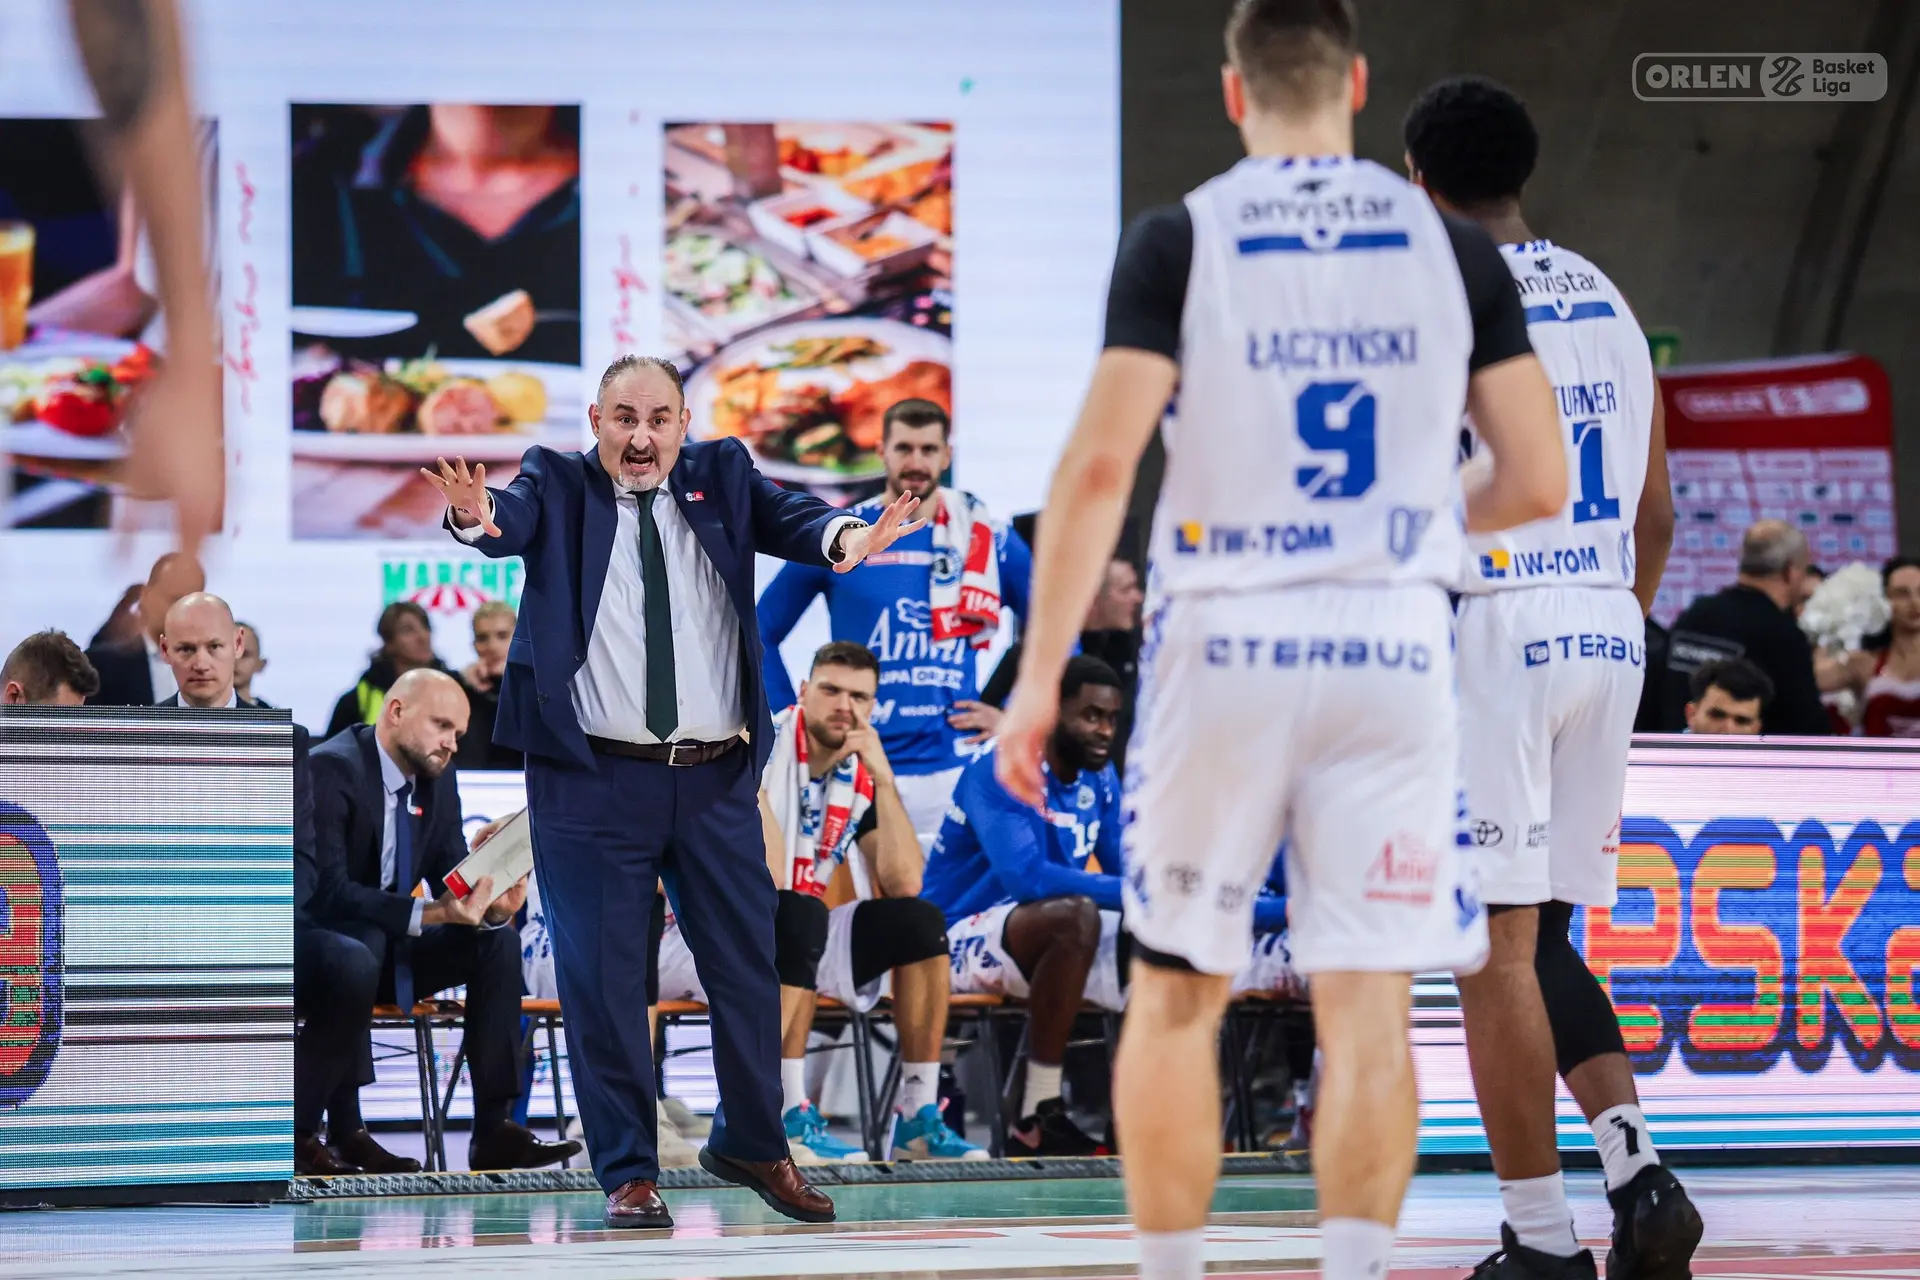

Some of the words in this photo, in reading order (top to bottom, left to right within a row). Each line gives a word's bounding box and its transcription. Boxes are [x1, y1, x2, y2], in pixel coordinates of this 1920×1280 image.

[1240, 193, 1396, 224] anvistar
[1247, 326, 1417, 375] ŁĄCZYŃSKI
[1295, 381, 1376, 500] 9
[1573, 421, 1619, 523] 1
[1210, 524, 1333, 552] IW-TOM
[1554, 634, 1645, 667] TERBU
